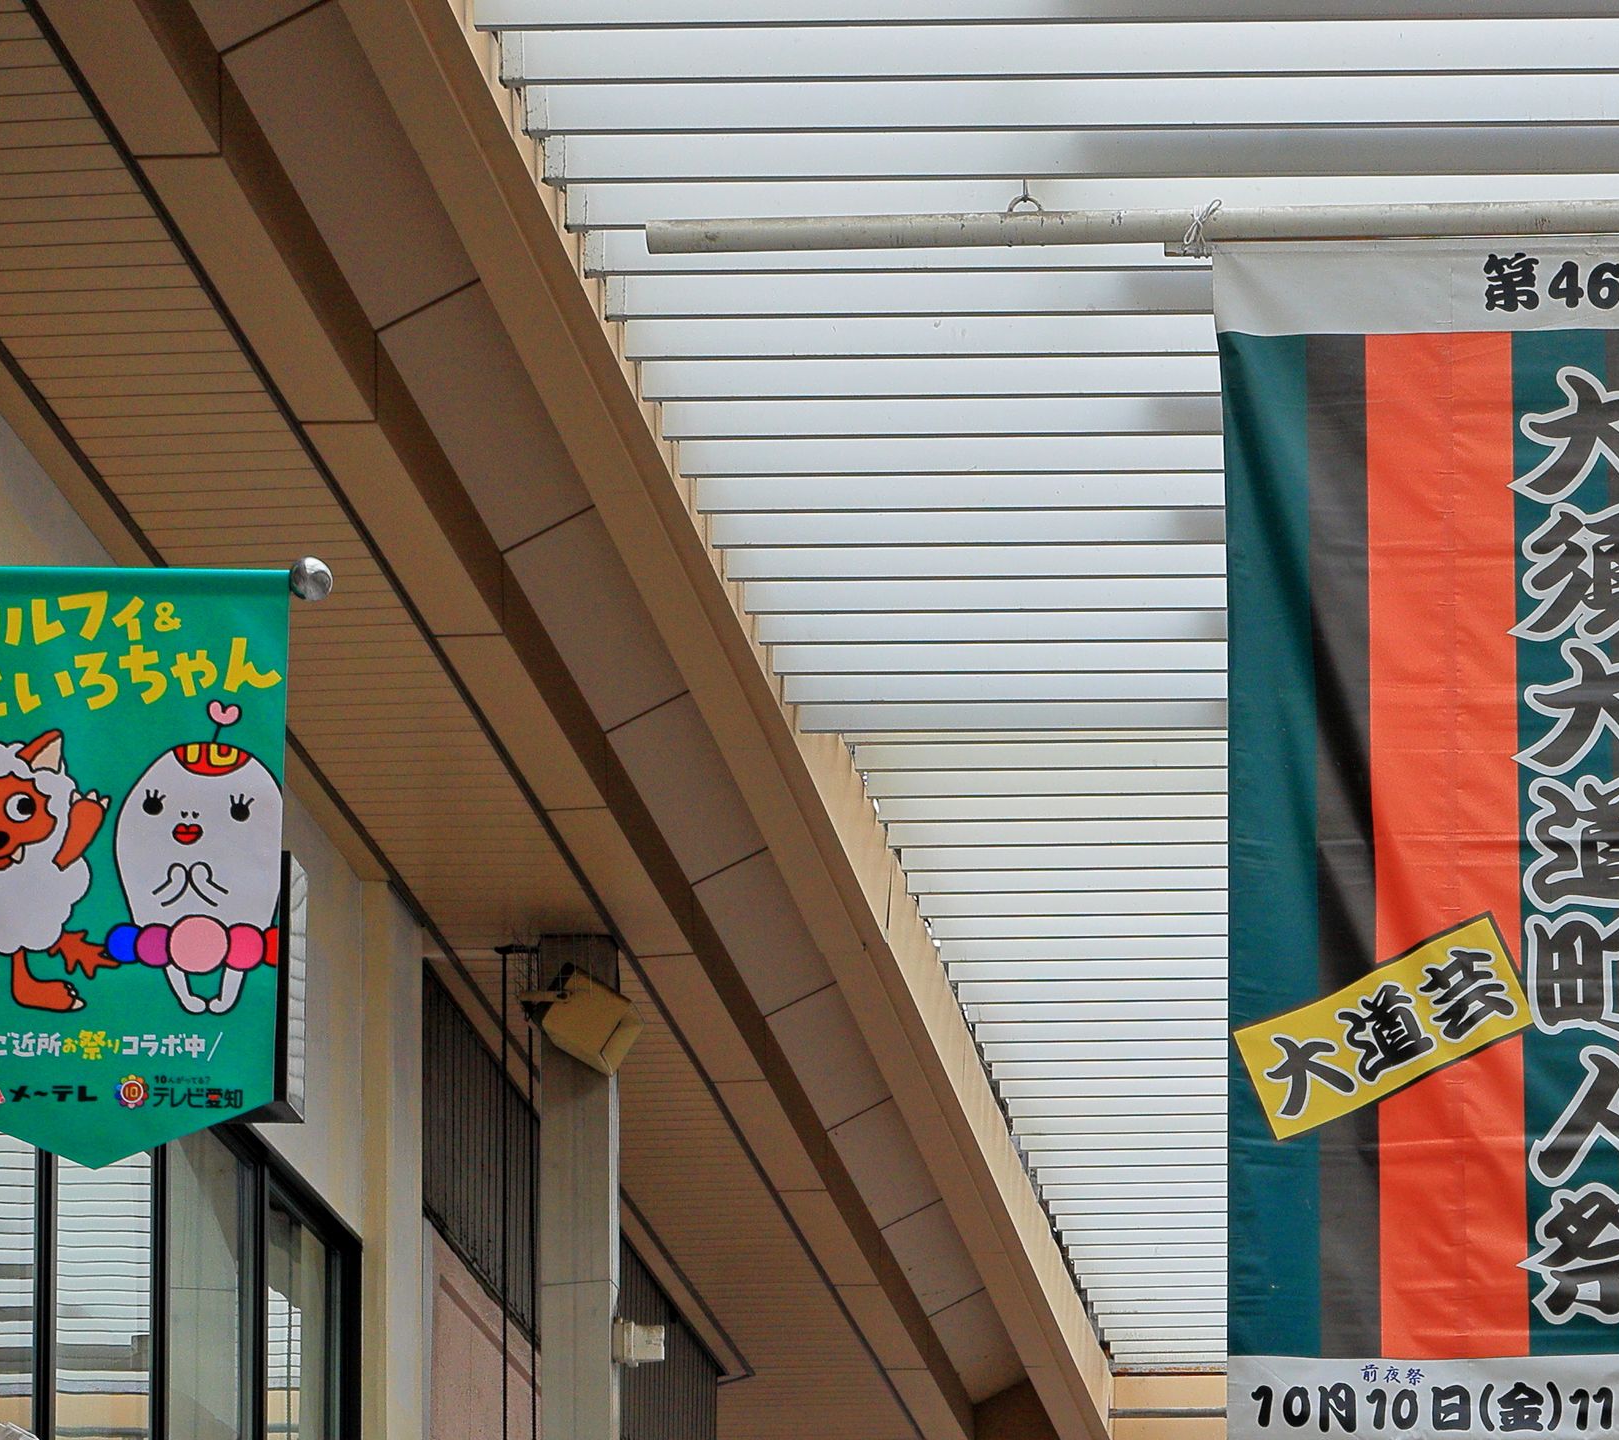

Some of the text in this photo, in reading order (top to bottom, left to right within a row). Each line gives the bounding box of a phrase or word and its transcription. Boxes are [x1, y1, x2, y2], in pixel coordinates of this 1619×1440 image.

[1261, 946, 1521, 1120] 大道芸
[152, 1086, 244, 1110] テレビ愛知
[1359, 1363, 1427, 1387] 前夜祭
